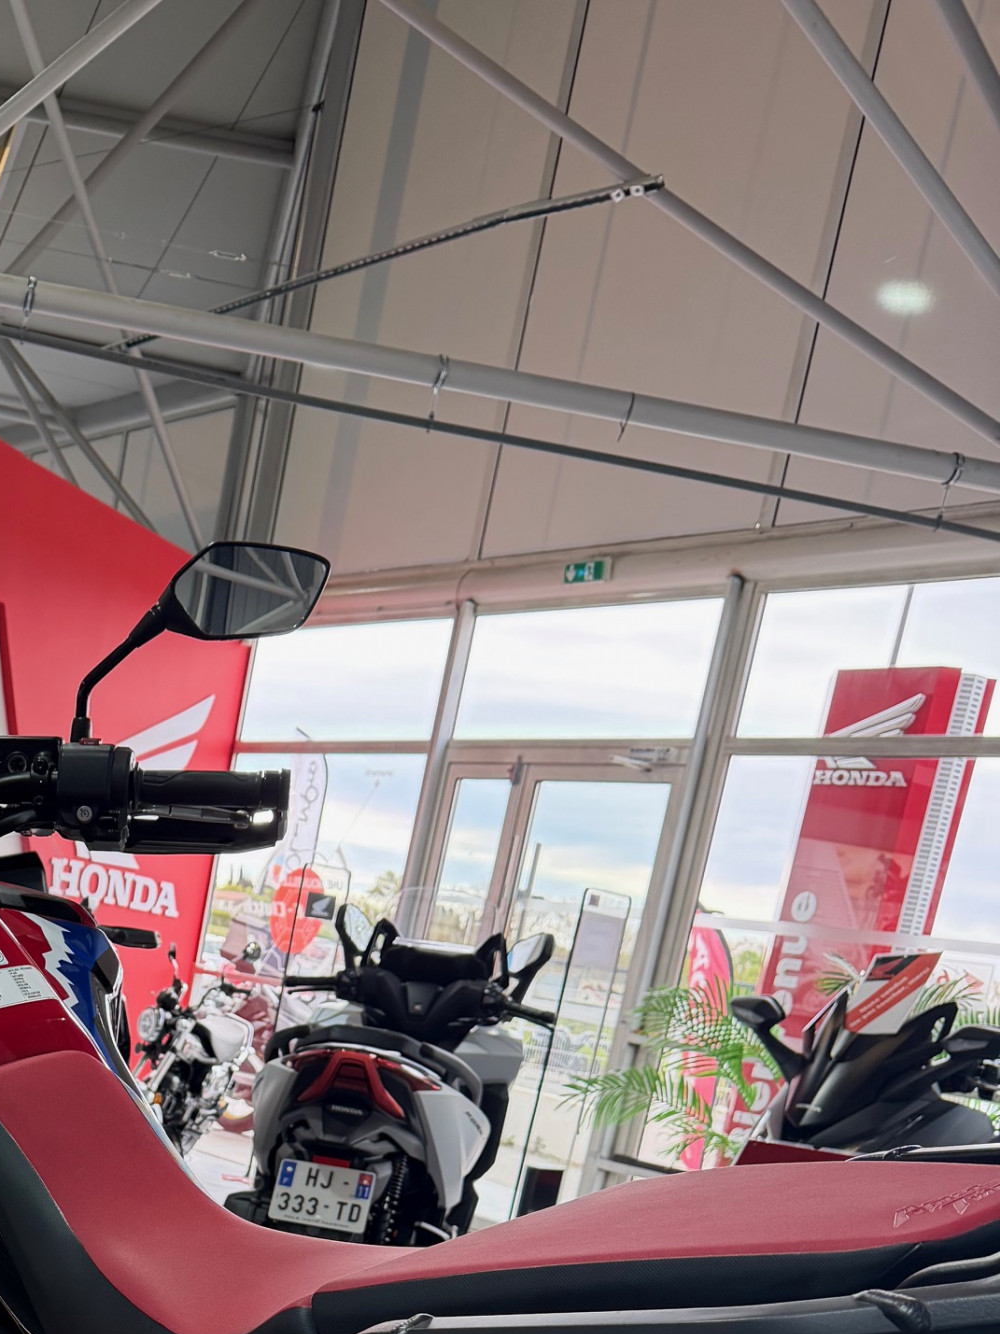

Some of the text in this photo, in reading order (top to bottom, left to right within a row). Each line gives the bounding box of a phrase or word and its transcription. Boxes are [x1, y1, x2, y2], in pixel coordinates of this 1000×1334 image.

[813, 769, 907, 787] HONDA
[48, 856, 180, 919] HONDA
[331, 1104, 364, 1116] HONDA
[358, 1186, 370, 1198] 11
